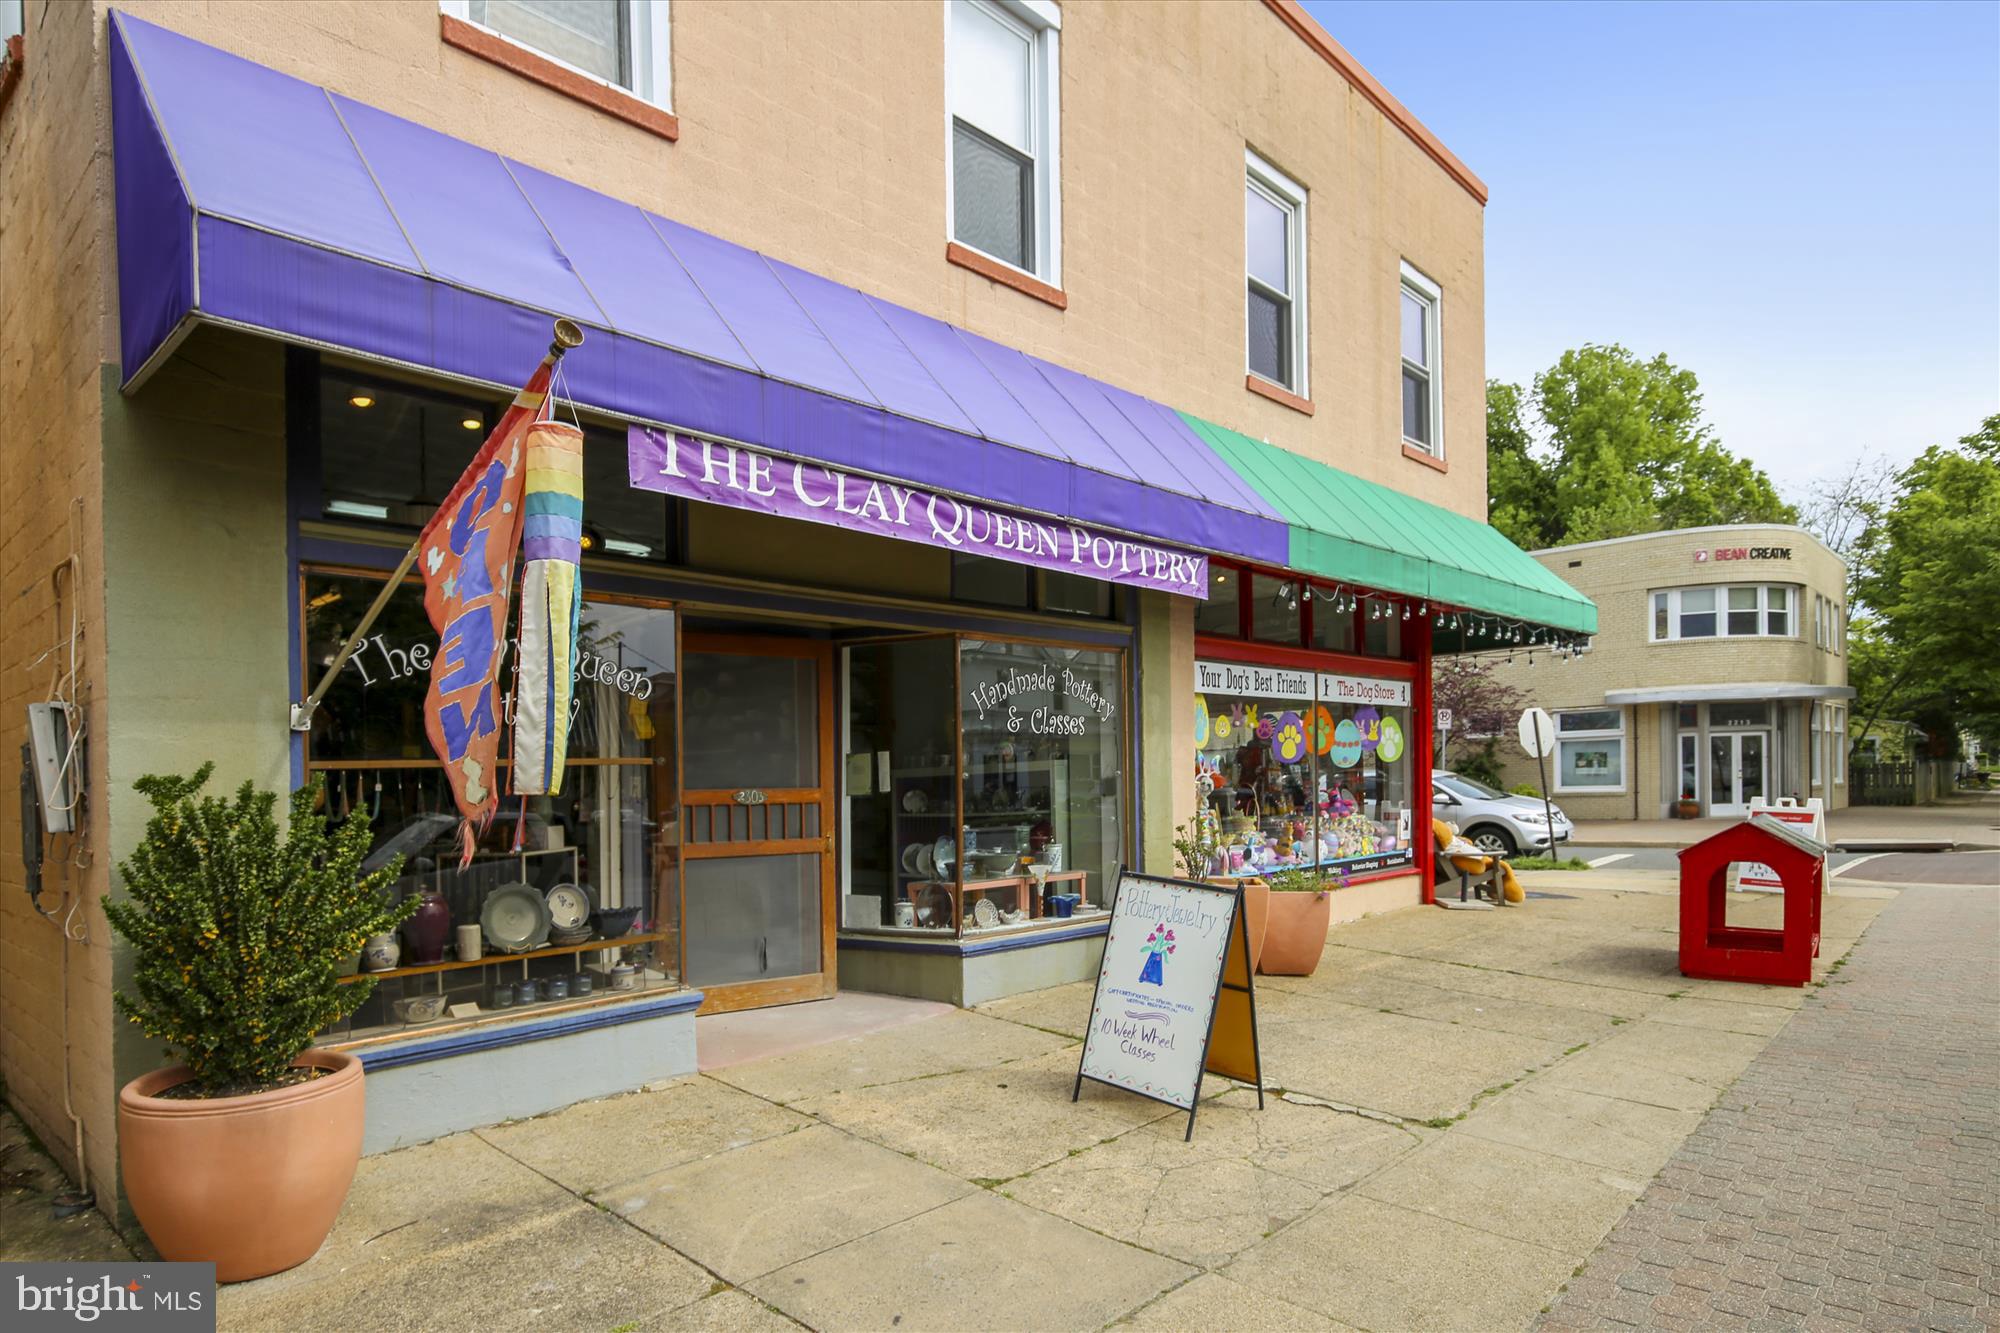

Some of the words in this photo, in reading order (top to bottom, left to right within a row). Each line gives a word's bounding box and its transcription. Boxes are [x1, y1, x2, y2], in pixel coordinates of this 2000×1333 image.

[646, 425, 776, 498] THE
[792, 460, 915, 526] CLAY
[925, 494, 1059, 559] QUEEN
[1071, 526, 1203, 587] POTTERY
[1714, 547, 1749, 561] BEAN
[1750, 547, 1792, 561] CREATIVE
[348, 633, 432, 688] The
[970, 664, 1056, 720] Handmade
[1061, 667, 1115, 722] Pottery
[1199, 665, 1222, 688] Your
[1226, 668, 1250, 695] Dog's
[1254, 670, 1273, 693] Best
[1277, 673, 1307, 695] Friends
[1337, 680, 1355, 697] The
[1357, 682, 1374, 702] Dog
[1374, 684, 1396, 700] Store
[1007, 705, 1023, 733] &
[1031, 706, 1086, 736] Classes
[1124, 888, 1166, 927] Pottery
[1166, 894, 1217, 938] Jewelry
[1101, 1018, 1112, 1035] 10
[1113, 1019, 1138, 1040] Week
[1141, 1024, 1176, 1050] Wheel
[1120, 1039, 1156, 1062] Classes
